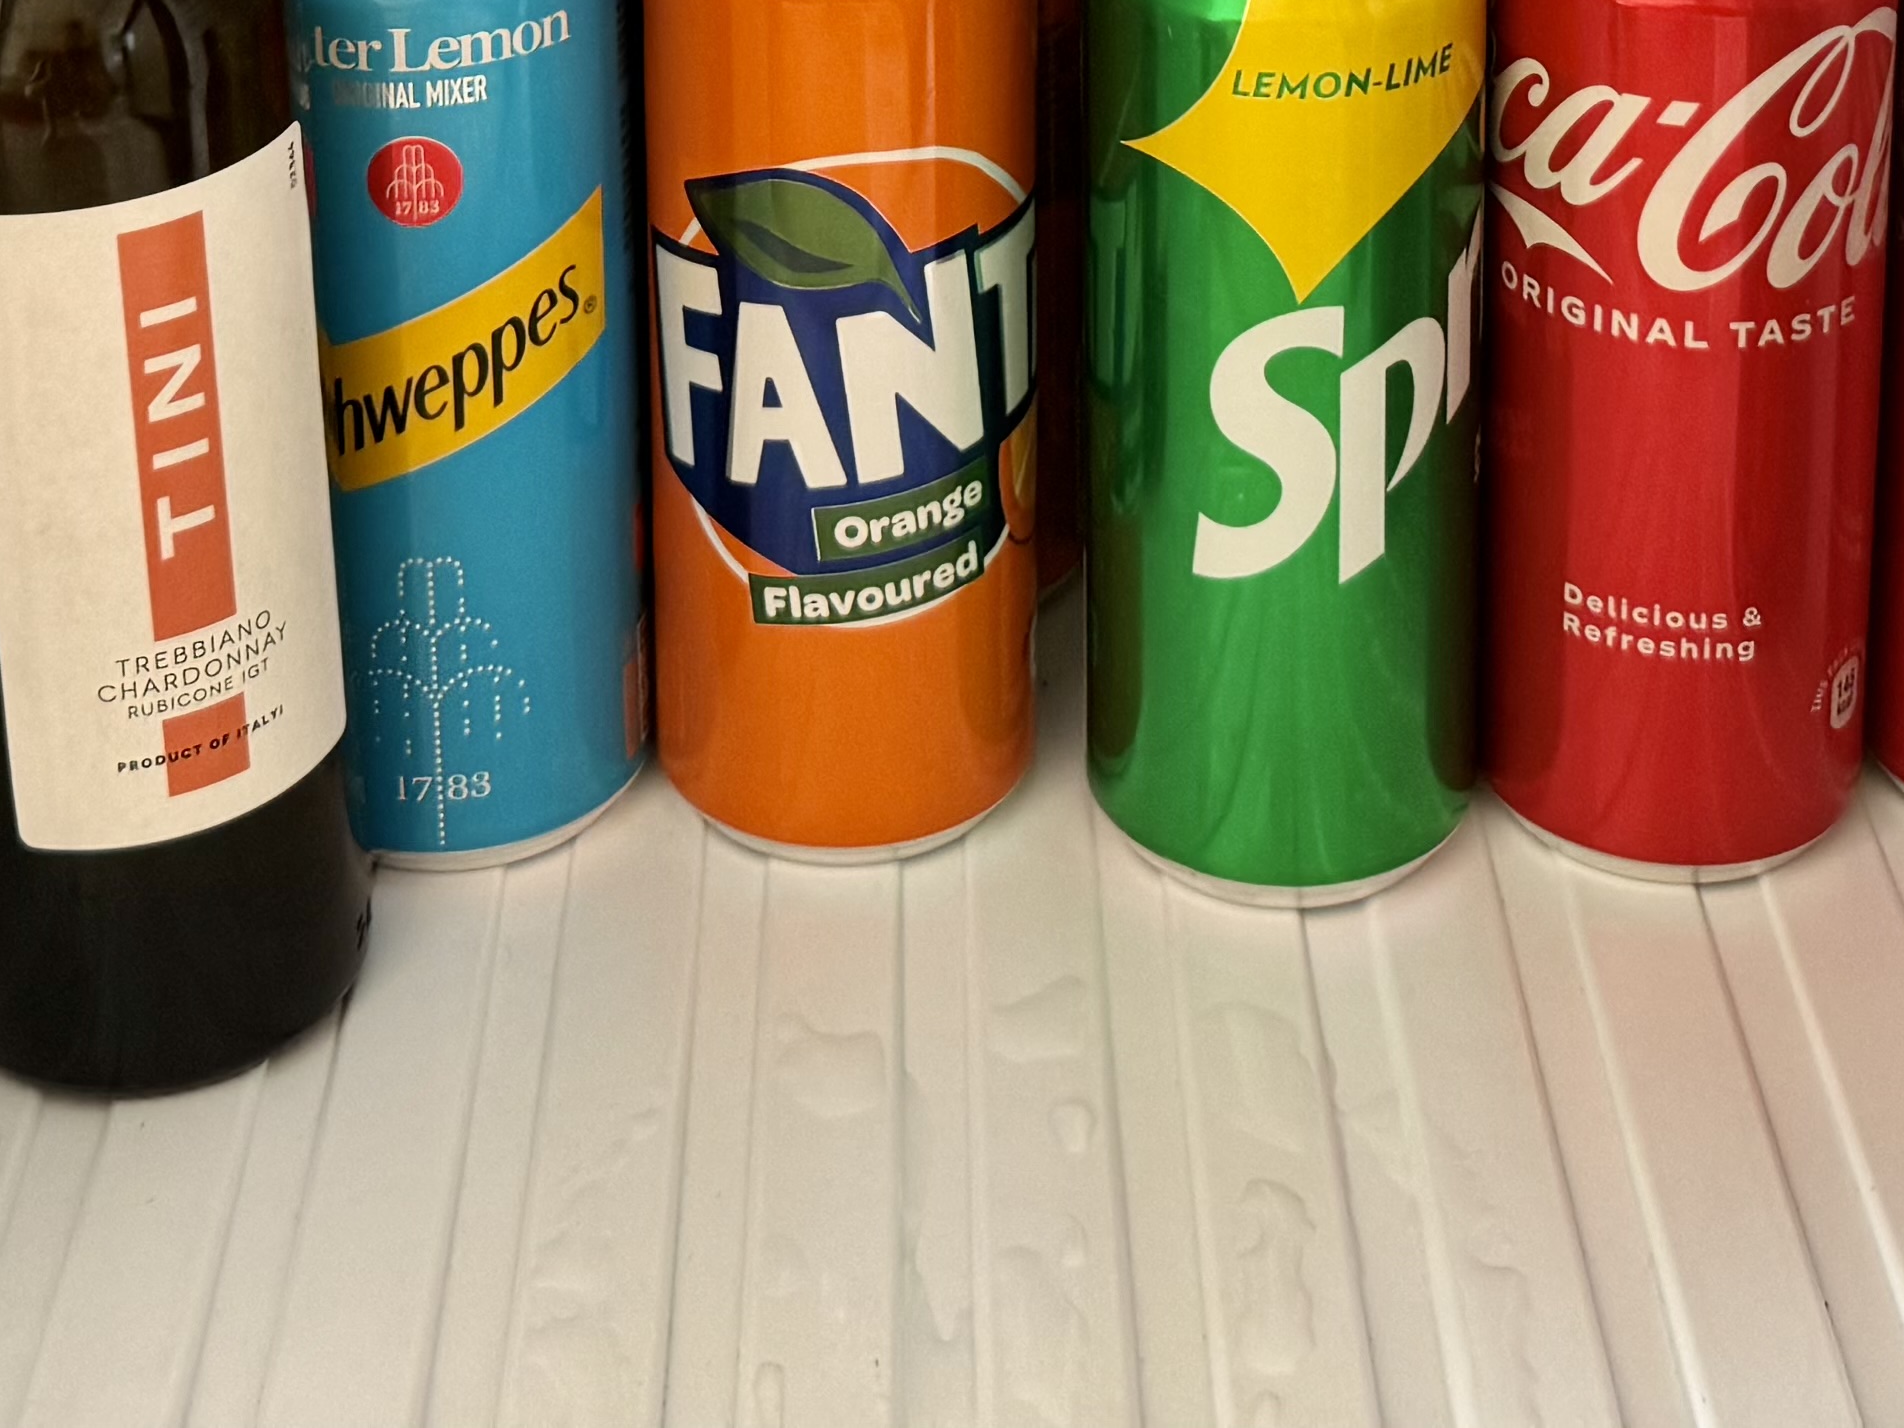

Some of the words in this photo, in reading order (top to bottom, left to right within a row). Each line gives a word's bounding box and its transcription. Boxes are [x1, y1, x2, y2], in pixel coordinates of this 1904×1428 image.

[386, 9, 572, 73] Lemon
[1231, 42, 1454, 101] LEMON-LIME
[426, 74, 488, 108] MIXER
[1501, 260, 1710, 350] ORIGINAL
[1729, 295, 1857, 349] TASTE
[138, 295, 219, 564] TINI
[833, 476, 984, 550] Orange
[763, 540, 980, 623] Flavoured
[1562, 579, 1730, 632] Delicious
[1741, 605, 1764, 629] &
[97, 620, 287, 703] CHARDONNAY
[115, 609, 272, 678] TREBBIANO
[1562, 609, 1758, 664] Refreshing
[127, 675, 235, 719] RUBICONE
[242, 657, 270, 685] IGT
[116, 744, 202, 773] PRODUCT
[209, 733, 231, 750] OF
